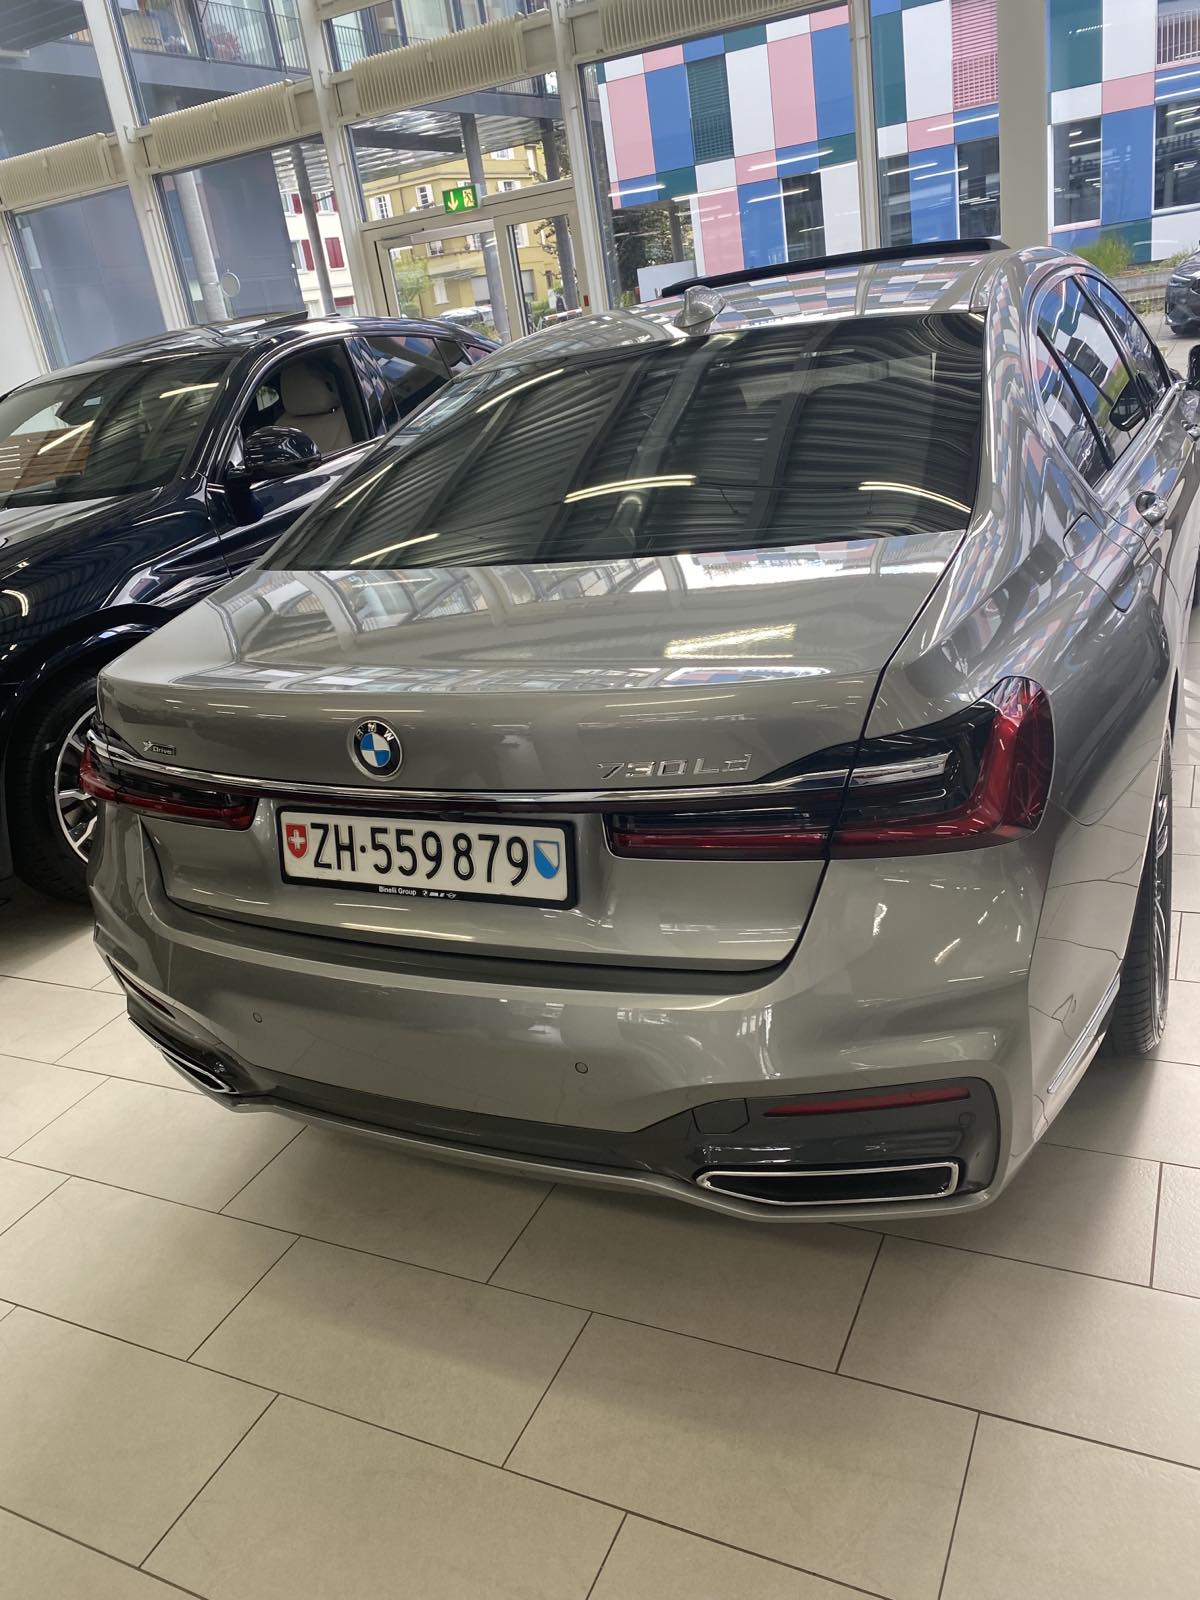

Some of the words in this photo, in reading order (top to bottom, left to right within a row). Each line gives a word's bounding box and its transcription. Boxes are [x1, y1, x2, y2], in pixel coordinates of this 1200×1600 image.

[355, 722, 395, 741] BMW
[597, 753, 752, 780] 730Ld
[397, 887, 417, 896] Group
